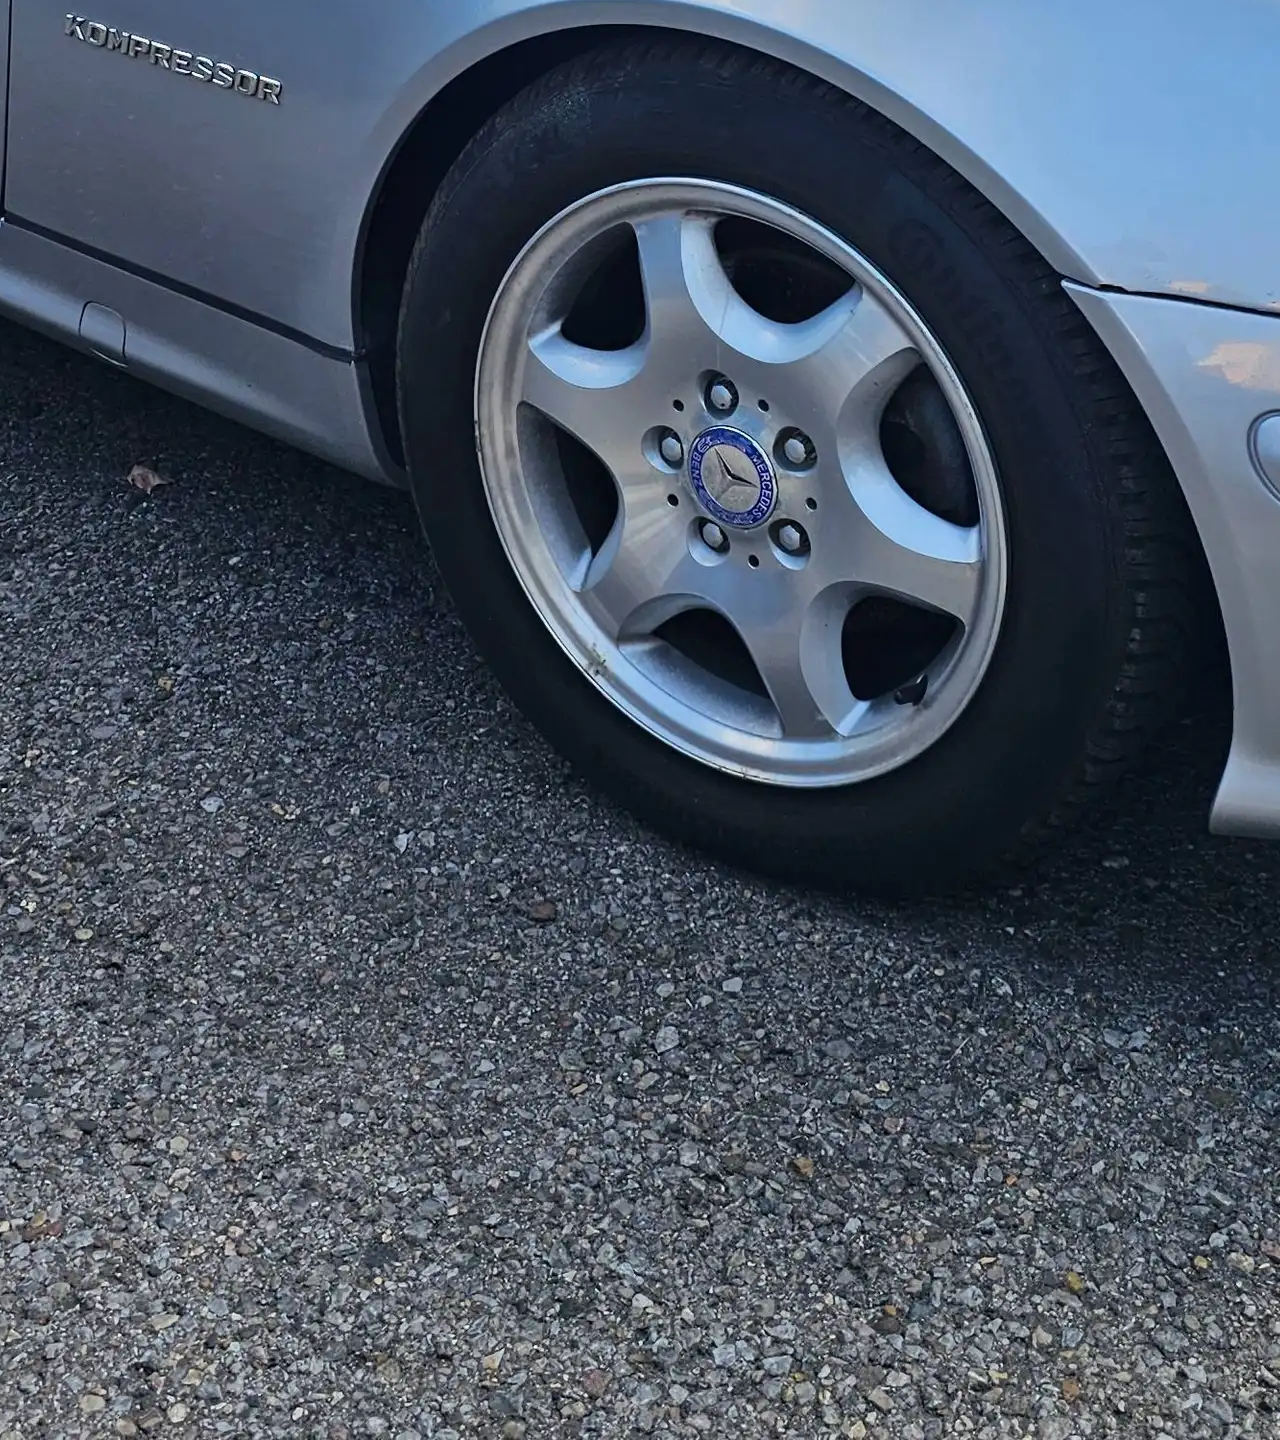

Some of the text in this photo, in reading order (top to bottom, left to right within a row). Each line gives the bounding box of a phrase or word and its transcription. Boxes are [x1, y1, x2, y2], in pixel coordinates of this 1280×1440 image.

[62, 11, 286, 106] KOMPRESSOR
[691, 453, 705, 488] BENZ
[750, 453, 773, 519] MERCEDES
